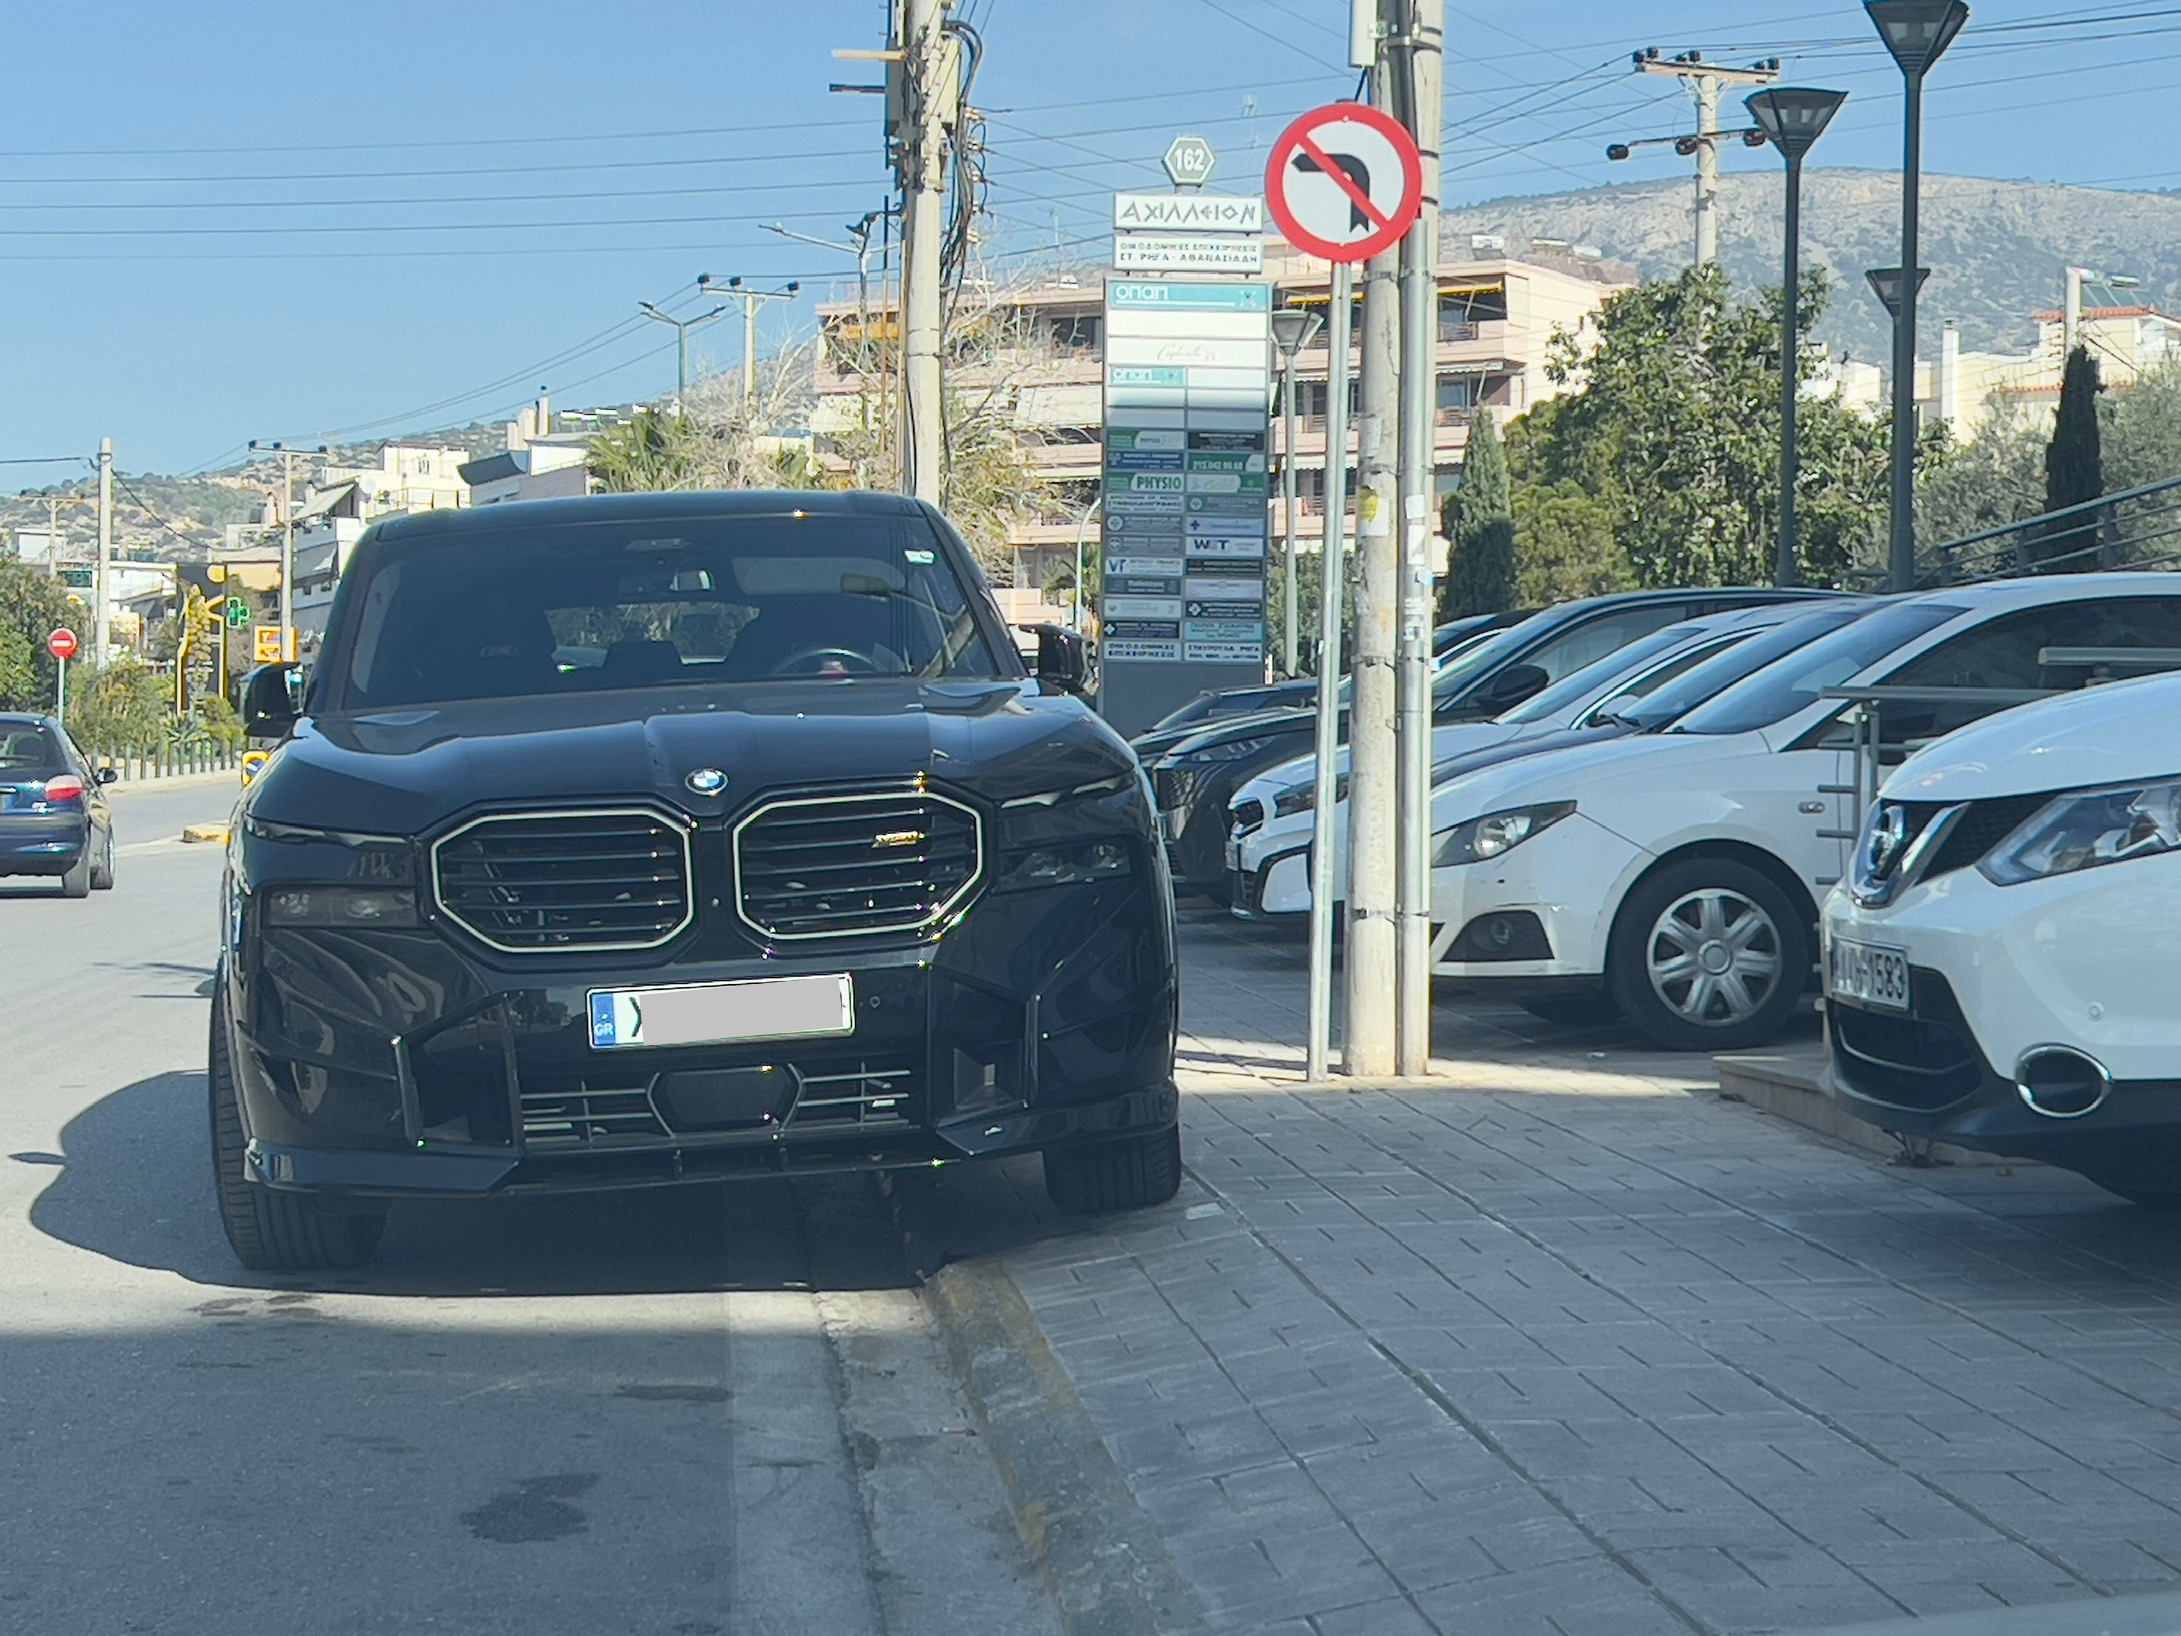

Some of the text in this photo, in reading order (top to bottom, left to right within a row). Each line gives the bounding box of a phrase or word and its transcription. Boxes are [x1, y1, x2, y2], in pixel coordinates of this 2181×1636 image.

[1174, 147, 1205, 171] 162
[1137, 476, 1182, 489] PHYSIO
[593, 1022, 614, 1036] GR
